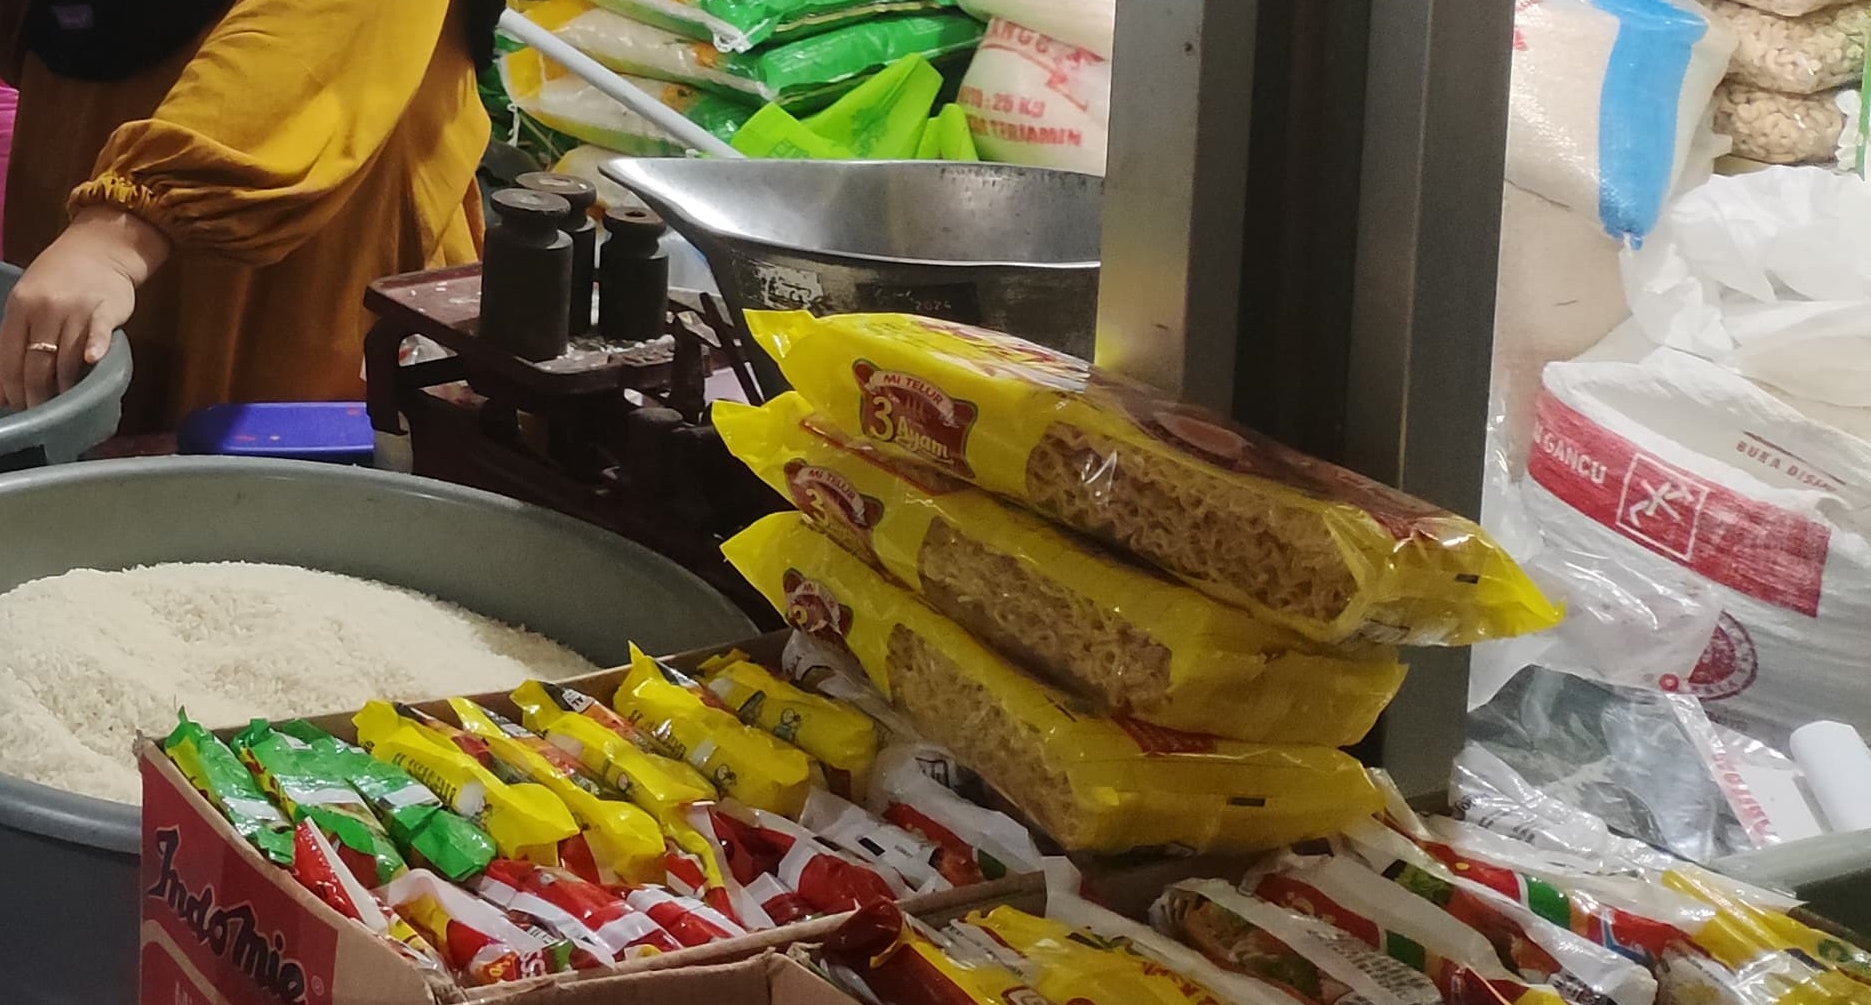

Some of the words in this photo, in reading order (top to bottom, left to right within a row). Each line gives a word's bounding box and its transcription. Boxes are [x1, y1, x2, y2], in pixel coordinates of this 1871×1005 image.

[883, 374, 901, 384] MI
[906, 377, 943, 404] TELUR
[869, 396, 894, 442] 3
[894, 415, 951, 459] Ayam
